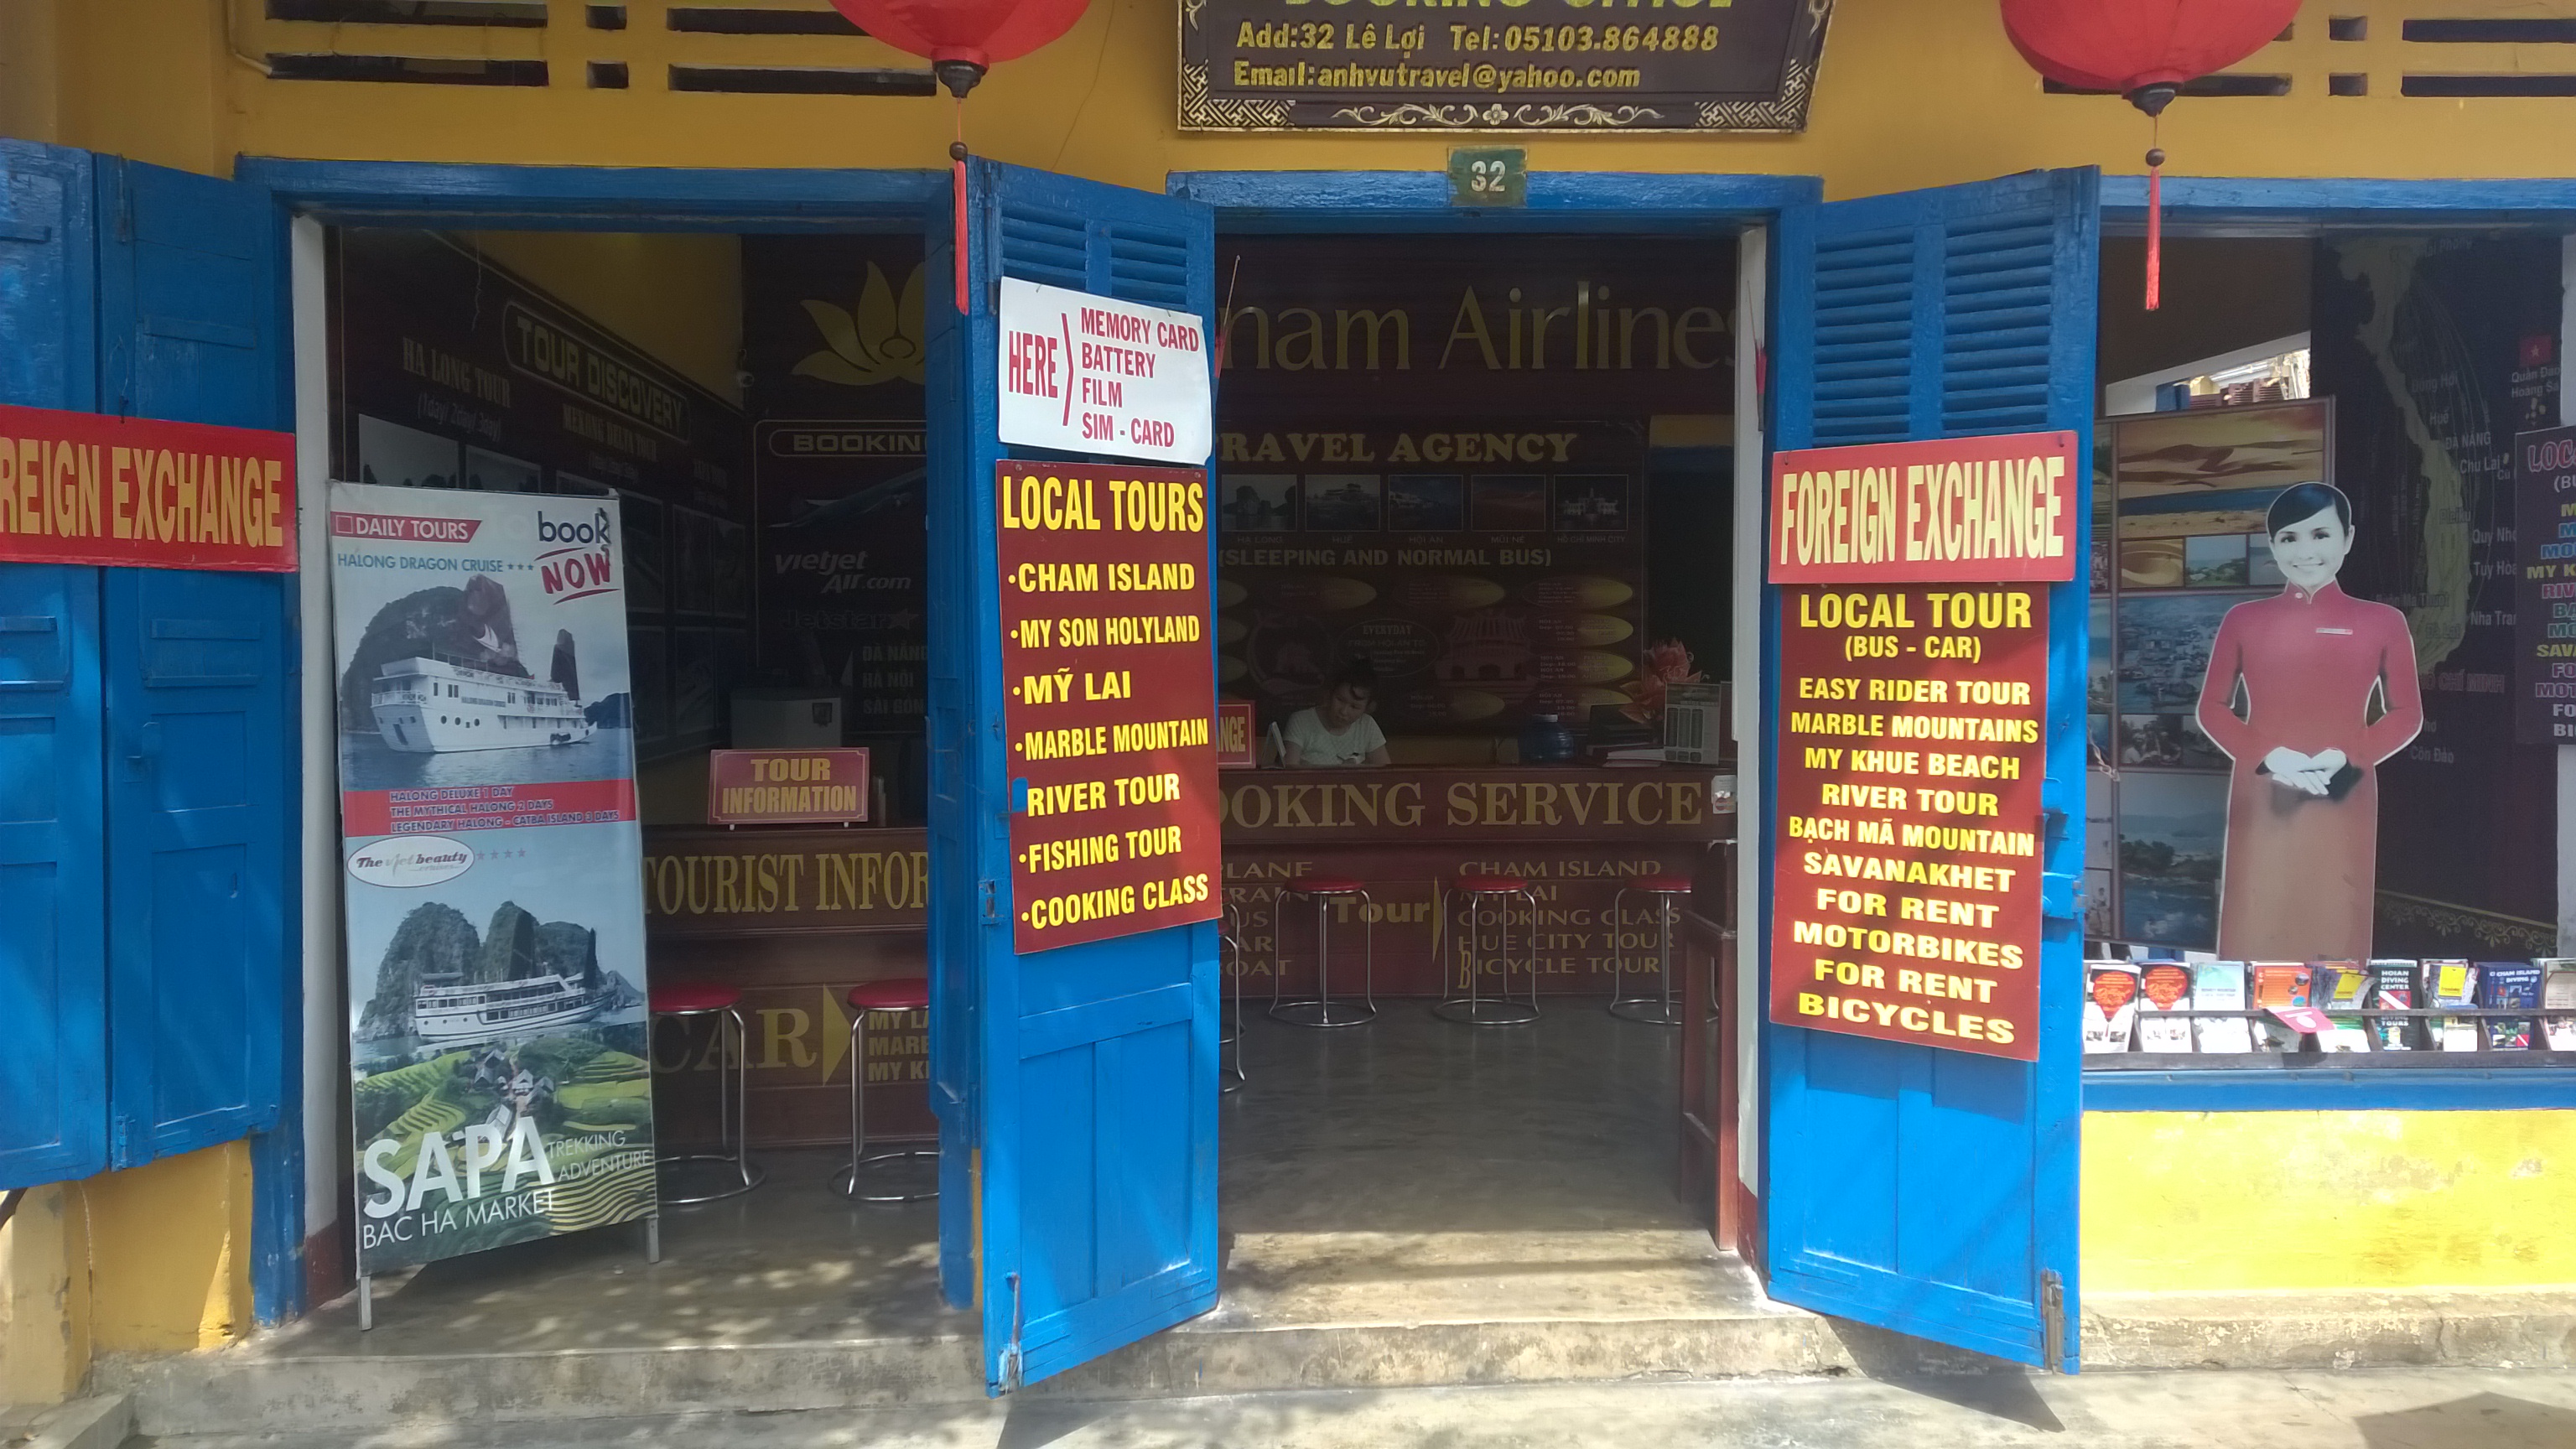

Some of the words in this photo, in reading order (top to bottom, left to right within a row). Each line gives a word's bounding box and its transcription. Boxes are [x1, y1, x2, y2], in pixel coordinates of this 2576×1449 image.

[1346, 22, 1376, 49] Lê
[1385, 24, 1425, 60] Lợi
[1470, 159, 1507, 193] 32
[1081, 307, 1151, 345] MEMORY
[1157, 322, 1200, 352] CARD
[517, 315, 580, 387] TOUR
[587, 352, 684, 434] DISCOVERY
[1008, 330, 1058, 398] HERE
[1082, 342, 1156, 378] BATTERY
[1082, 377, 1123, 408] FILM
[793, 434, 927, 453] BOOKIN
[1082, 412, 1114, 442] SIM
[1130, 418, 1175, 448] CARD
[1216, 433, 1376, 462] RAVEL
[1388, 433, 1576, 463] AGENCY
[2527, 439, 2576, 473] LOC
[111, 446, 283, 548] EXCHANGE
[1002, 475, 1101, 531] LOCAL
[1109, 480, 1204, 532] TOURS
[1780, 466, 1898, 565] FOREIGN
[1905, 455, 2064, 563] EXCHANGE
[356, 517, 406, 538] DAILY
[410, 519, 469, 541] TOURS
[538, 508, 611, 544] book
[337, 553, 397, 569] HALONG
[400, 556, 459, 571] DRAGON
[461, 558, 503, 573] CRUISE
[541, 548, 612, 595] NOW
[1343, 549, 1389, 566] AND
[1398, 549, 1490, 566] NORMAL
[1499, 548, 1552, 567] BUS)
[2527, 565, 2557, 579] MY
[1018, 563, 1099, 592] CHAM
[1108, 563, 1196, 590] ISLAND
[1800, 592, 1915, 629] LOCAL
[1927, 592, 2033, 629] TOUR
[1020, 619, 1052, 649] MY
[1058, 617, 1099, 647] SON
[1105, 615, 1200, 646] HOLYLAND
[1845, 636, 1900, 662] (BUS
[1924, 636, 1981, 663] CAR)
[1023, 667, 1074, 704] MỸ
[1085, 670, 1132, 700] LAI
[1800, 677, 1862, 703] EASY
[1869, 678, 1948, 704] RIDER
[1957, 680, 2032, 706] TOUR
[1025, 727, 1108, 761] MARBLE
[1113, 718, 1209, 753] MOUNTAIN
[1790, 711, 1884, 738] MARBLE
[1892, 715, 2038, 744] MOUNTAINS
[750, 758, 831, 782] TOUR
[1805, 747, 1843, 771] MY
[1852, 750, 1919, 776] KHUE
[1928, 753, 2020, 781] BEACH
[390, 788, 439, 802] HALONG
[440, 787, 480, 801] DELUXE
[491, 785, 514, 798] DAY
[391, 806, 411, 818] THE
[414, 802, 467, 817] MYTHICAL
[470, 801, 516, 813] HALONG
[517, 800, 525, 813] 2
[527, 799, 554, 811] DAYS
[722, 786, 857, 814] INFORMATION
[1027, 781, 1107, 817] RIVER
[1114, 773, 1180, 808] TOUR
[1219, 782, 1426, 828] OKING
[1446, 781, 1702, 827] SERVICE
[1821, 782, 1907, 812] RIVER
[1917, 788, 1999, 817] TOUR
[391, 819, 454, 834] LEGENDARY
[458, 817, 503, 829] HALONG
[512, 813, 546, 827] CATBA
[548, 812, 584, 824] ISLAND
[595, 810, 620, 821] DAYS
[1789, 816, 1850, 845] BẠCH
[1857, 816, 1896, 845] MÃ
[1902, 822, 2034, 857] MOUNTAIN
[356, 856, 383, 869] The
[415, 851, 468, 865] beauty
[1029, 834, 1119, 874] FISHING
[1124, 826, 1182, 860] TOUR
[642, 854, 804, 914] TOURIST
[1221, 861, 1313, 879] LANE
[1458, 860, 1548, 877] CHAM
[1558, 860, 1661, 877] ISLAND
[1804, 852, 2016, 893] SAVANAKHET
[1031, 886, 1135, 930] COOKING
[1143, 874, 1209, 911] CLASS
[1328, 896, 1431, 923] Tour
[1458, 908, 1592, 927] COOKING
[1817, 887, 1887, 918] FOR
[1901, 894, 2000, 929] RENT
[1794, 921, 2023, 970] MOTORBIKES
[1587, 957, 1660, 974] TOUR
[1814, 958, 1886, 991] FOR
[1900, 967, 1997, 1005] RENT
[1799, 991, 2015, 1046] BICYCLES
[868, 1062, 902, 1082] MY
[546, 1130, 626, 1160] TREKKING
[362, 1115, 556, 1220] SAPA
[558, 1149, 651, 1182] ADVENTURE
[362, 1213, 413, 1250] BAC
[421, 1210, 458, 1239] HA
[465, 1189, 555, 1229] MARKET
